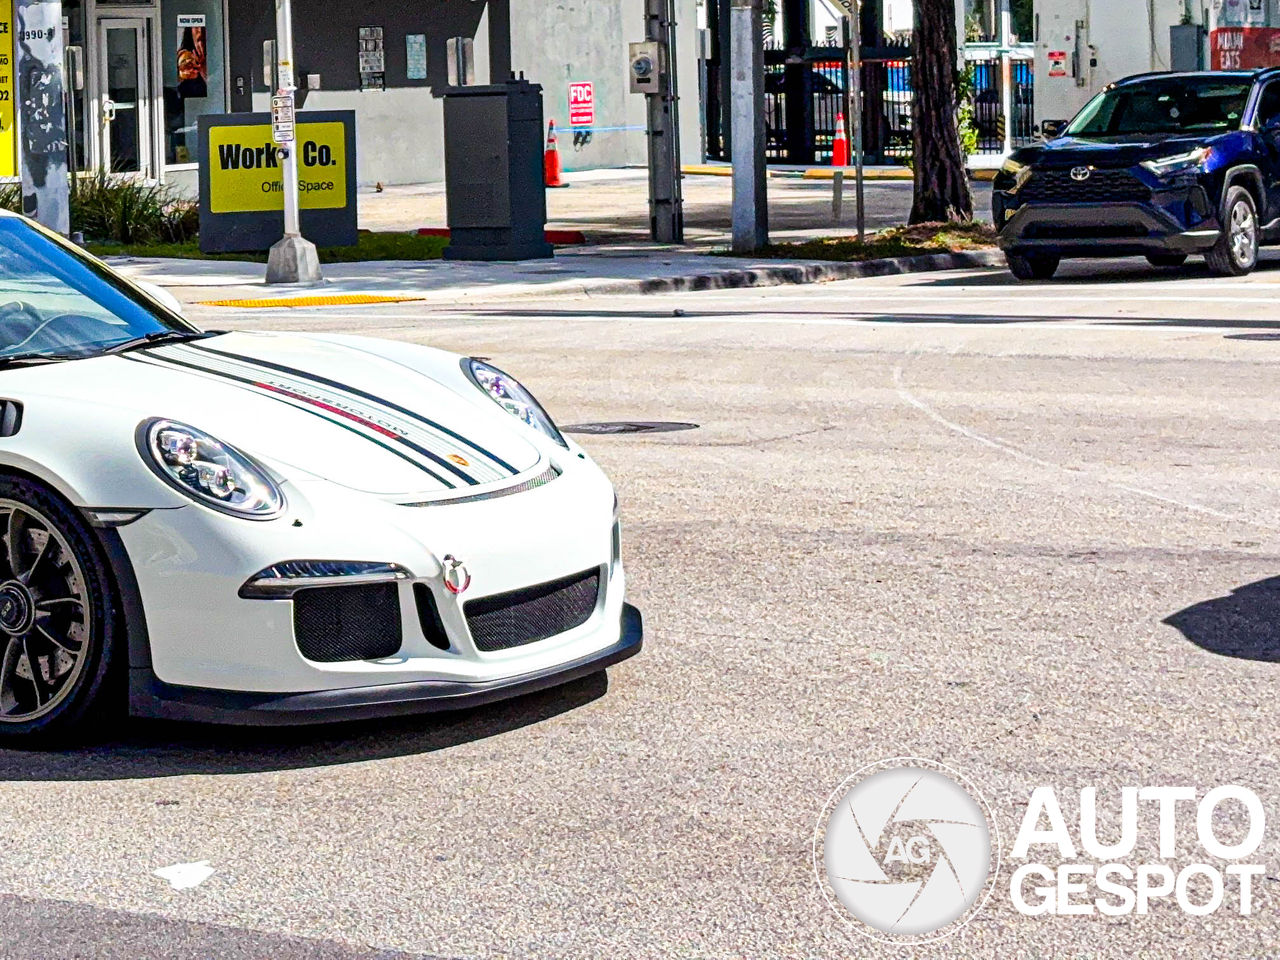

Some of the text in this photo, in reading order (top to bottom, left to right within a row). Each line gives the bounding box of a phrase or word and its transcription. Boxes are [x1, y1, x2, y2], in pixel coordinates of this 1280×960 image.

[1220, 50, 1240, 70] EATS
[570, 85, 592, 102] FDC
[218, 140, 336, 170] Work Co.
[298, 180, 334, 193] Space
